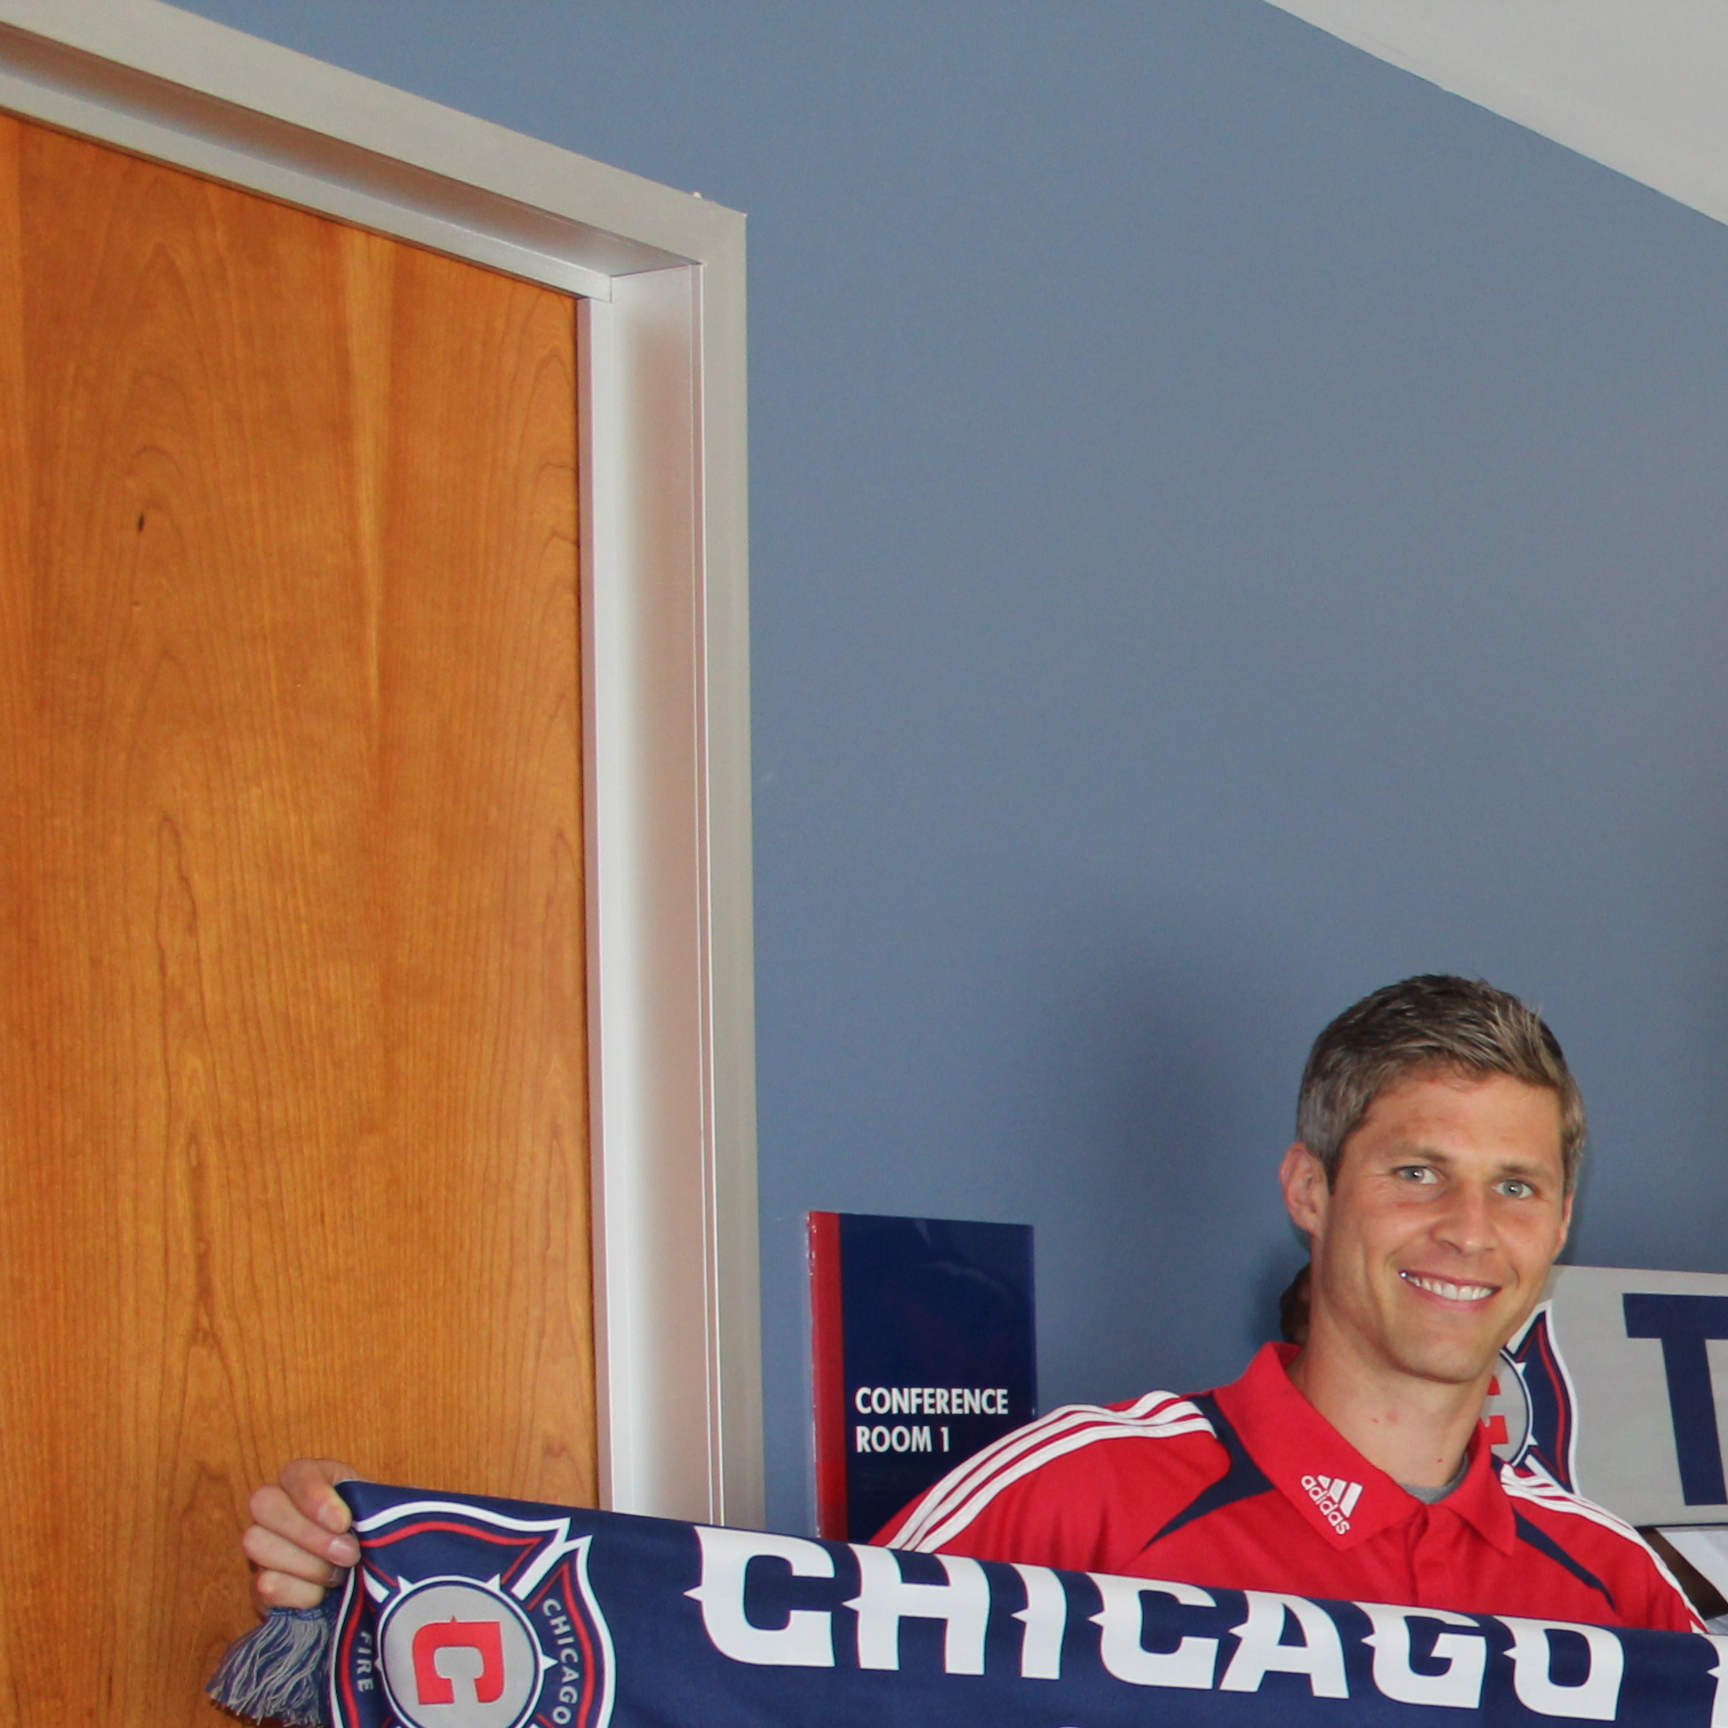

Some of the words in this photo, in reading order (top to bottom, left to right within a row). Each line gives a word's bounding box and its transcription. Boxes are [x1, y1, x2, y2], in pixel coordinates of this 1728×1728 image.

[855, 1387, 1009, 1415] CONFERENCE
[856, 1425, 932, 1453] ROOM
[940, 1426, 949, 1453] 1
[1301, 1475, 1351, 1535] adidas
[683, 1526, 1625, 1721] CHICAGO
[356, 1631, 373, 1693] FIRE
[543, 1598, 578, 1725] CHICAGO
